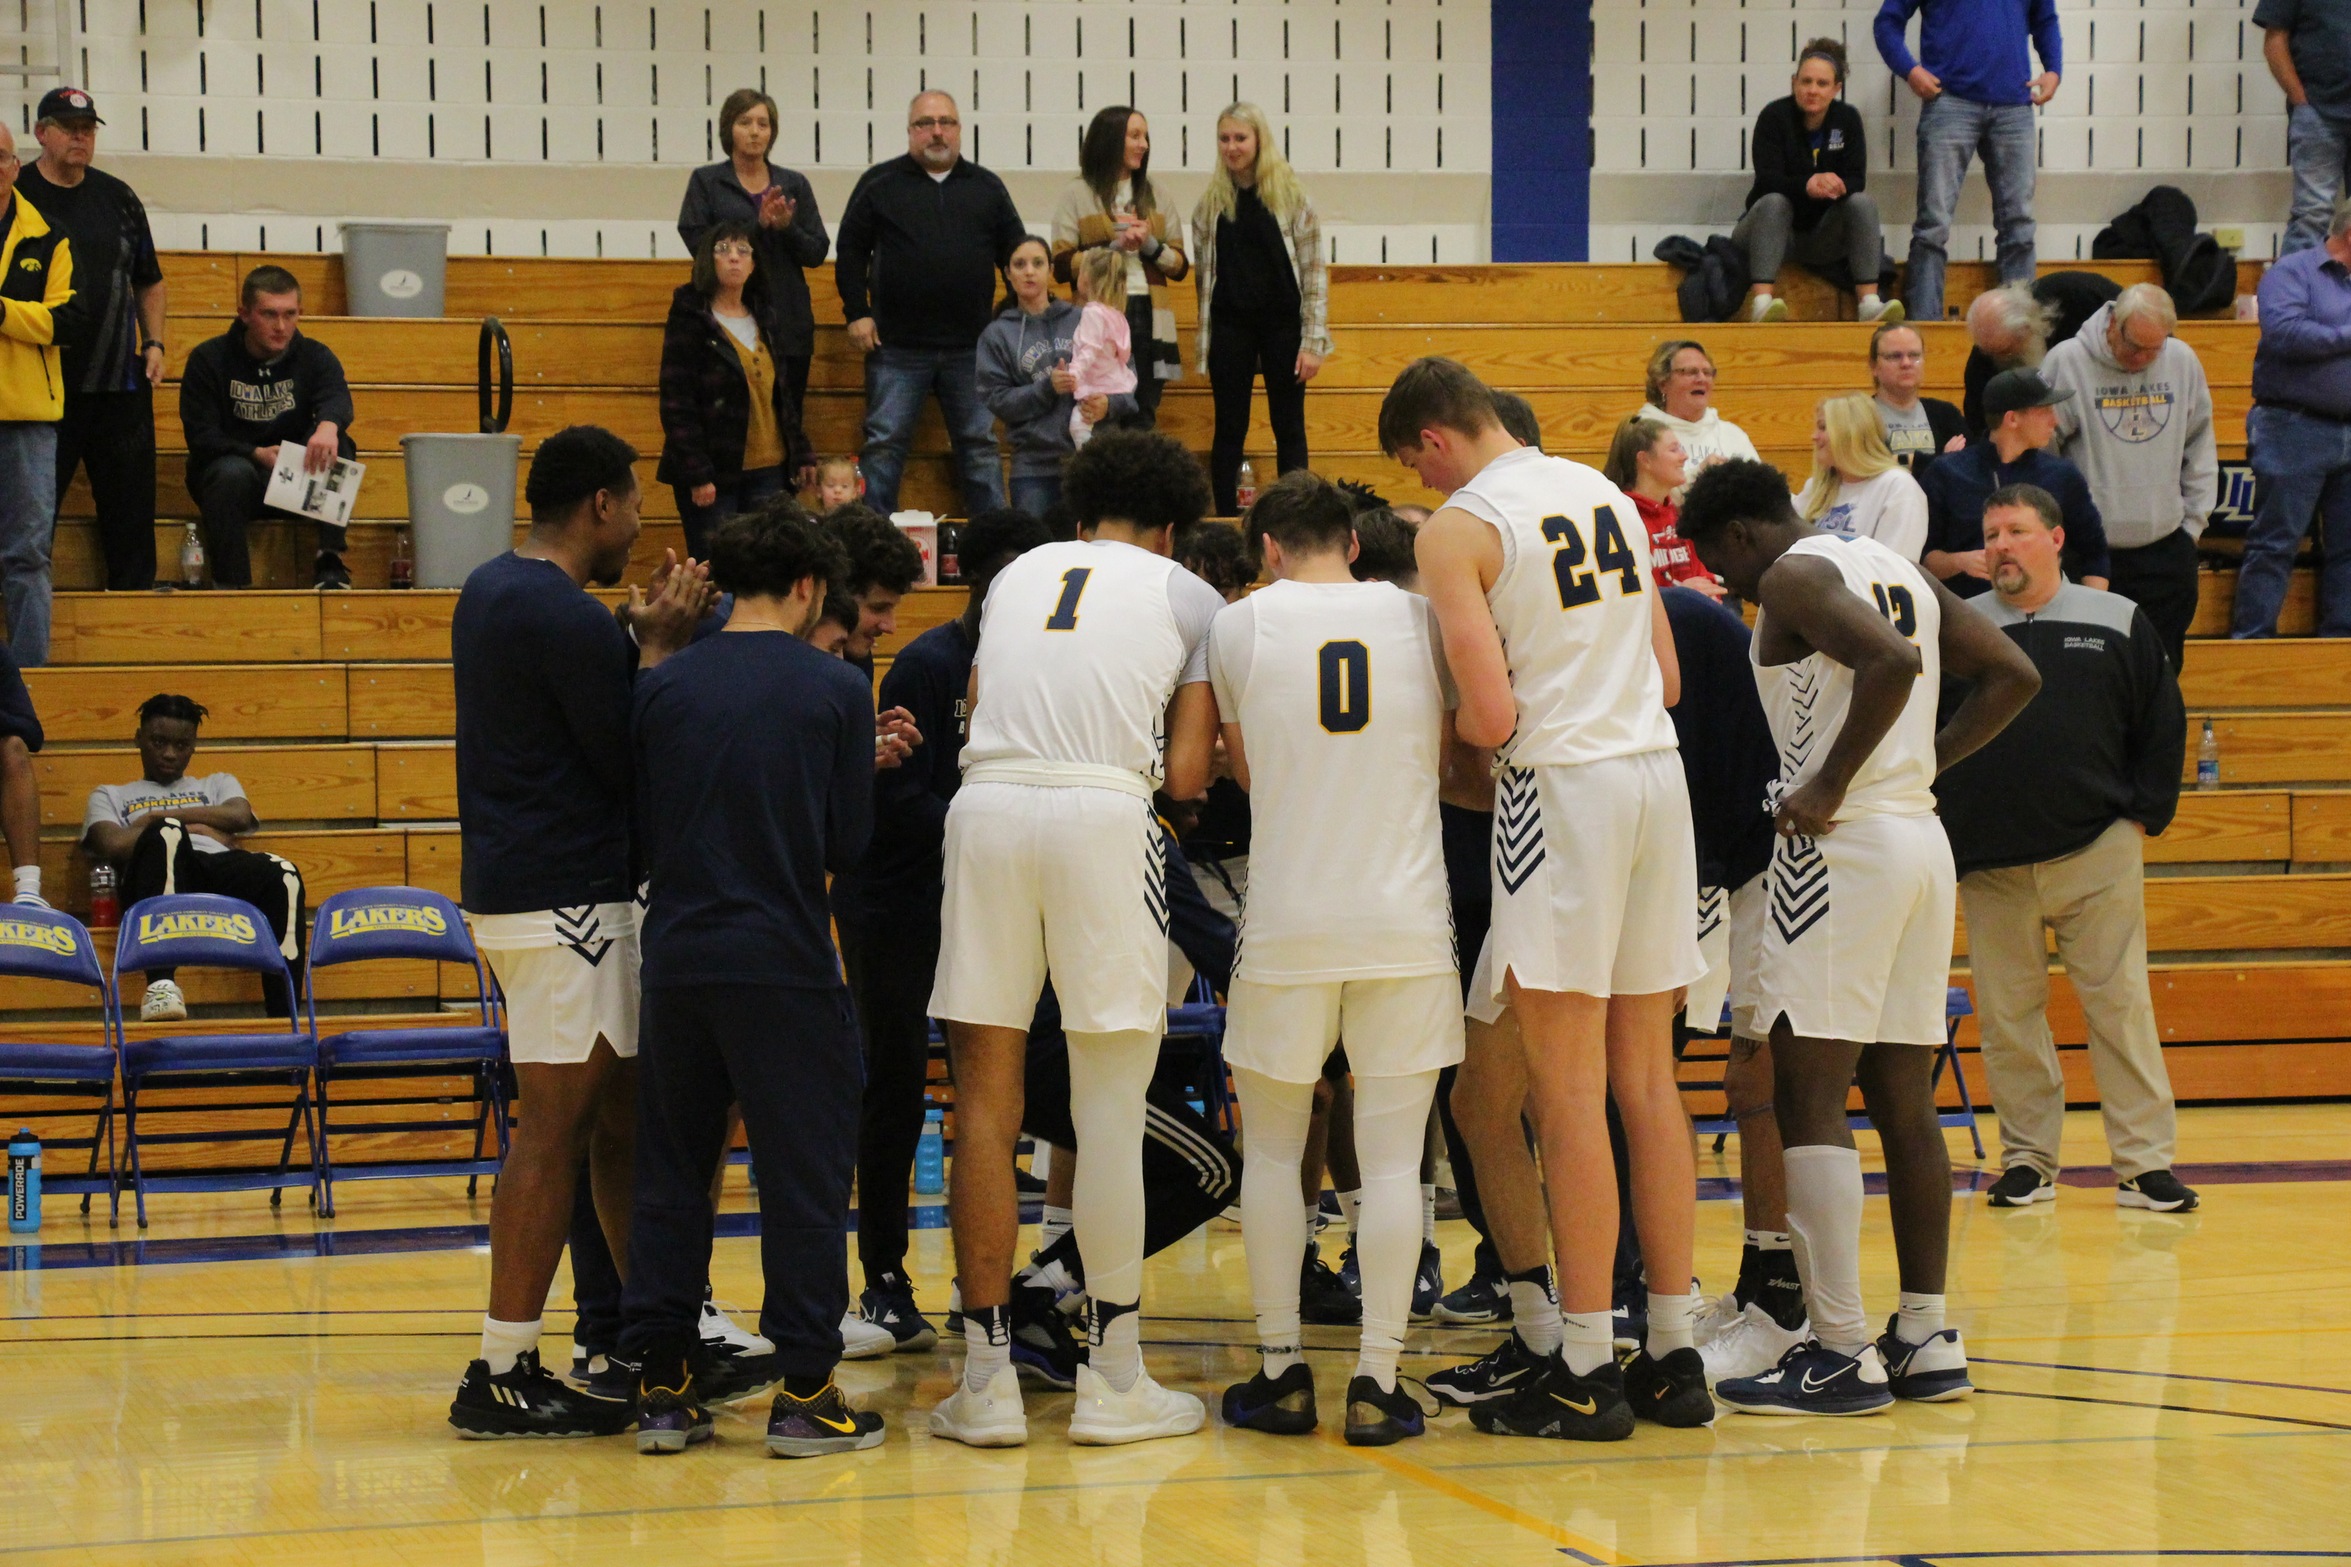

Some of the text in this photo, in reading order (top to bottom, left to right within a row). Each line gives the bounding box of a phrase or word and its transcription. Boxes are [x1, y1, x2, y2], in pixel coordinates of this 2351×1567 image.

[230, 379, 263, 402] IOWA
[2096, 382, 2170, 396] IOWA AKES
[1539, 502, 1644, 612] 24
[1044, 567, 1094, 631] 1
[2064, 642, 2105, 651] BASKETBALL
[1316, 638, 1372, 735] 0
[129, 796, 202, 813] BASKETBALL
[138, 914, 257, 941] LAKERS
[330, 906, 447, 935] LAKERS
[15, 1158, 25, 1219] POWERADE
